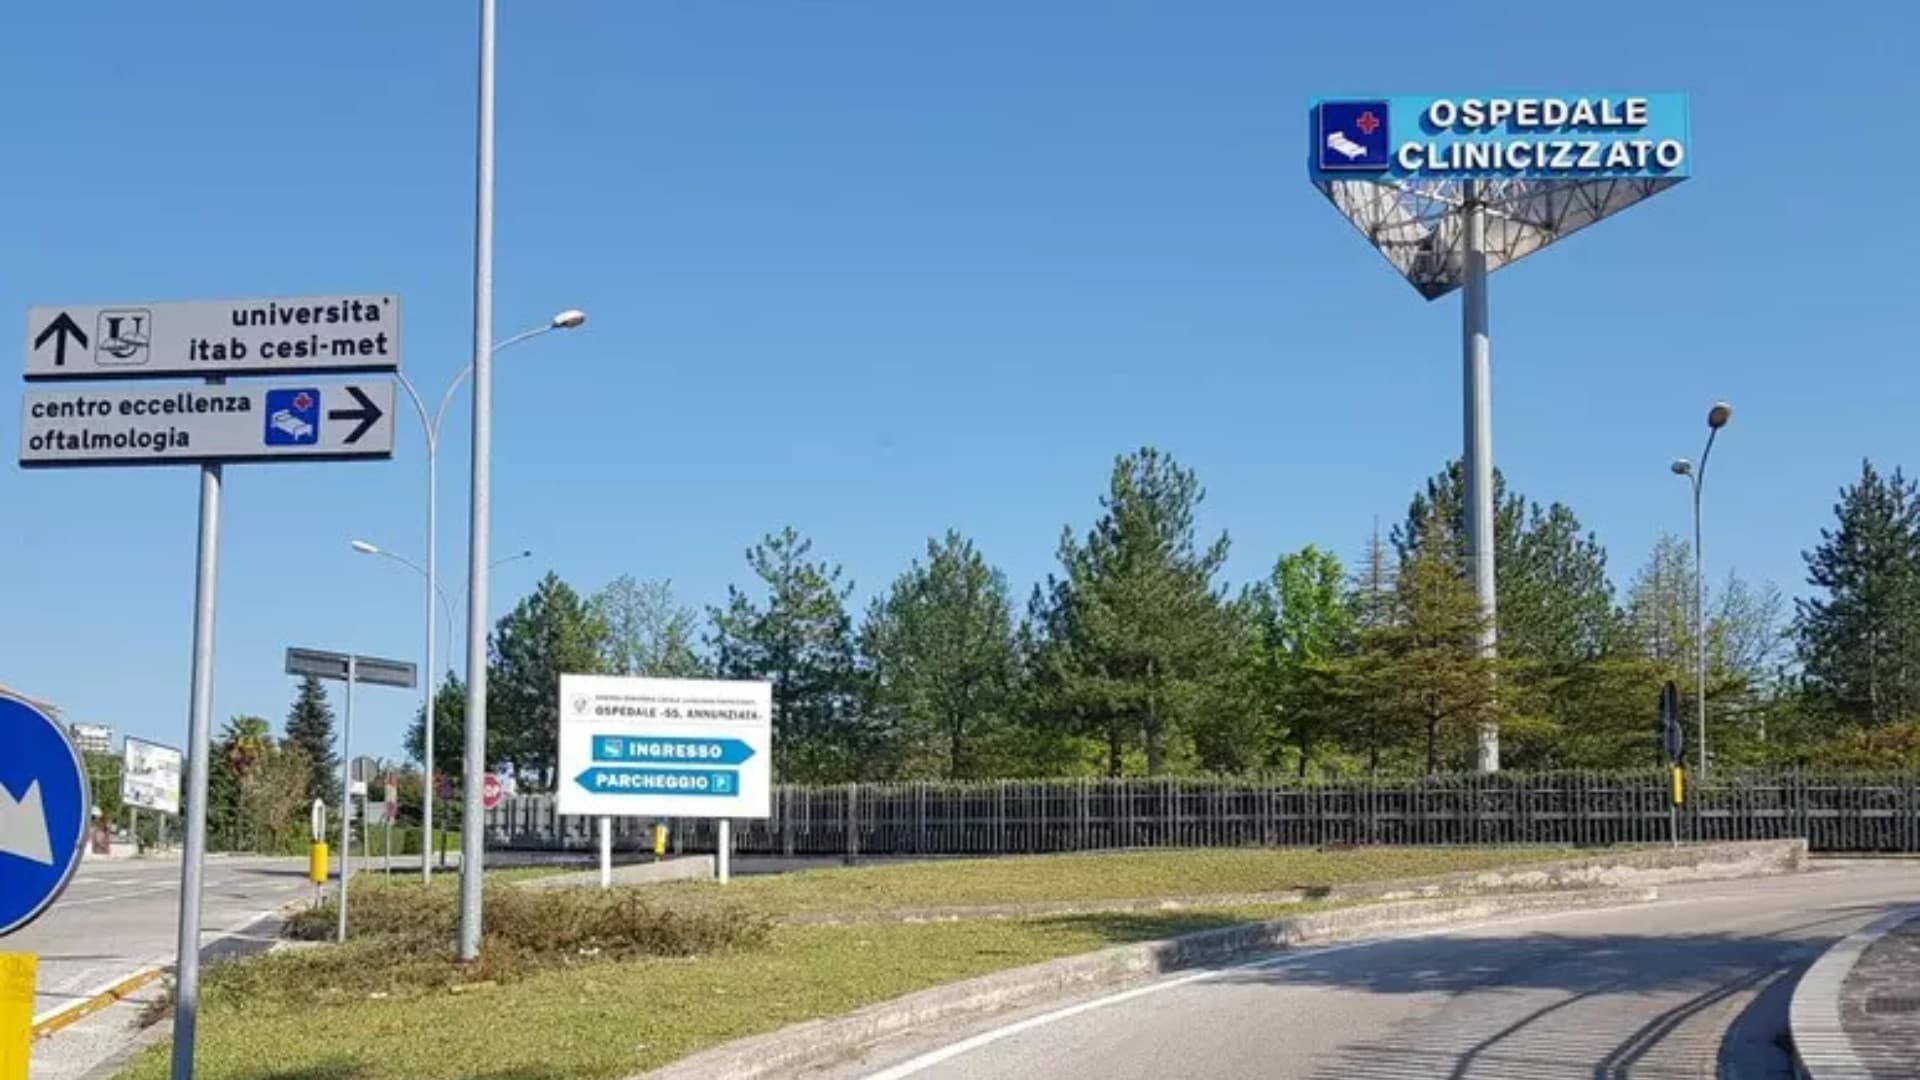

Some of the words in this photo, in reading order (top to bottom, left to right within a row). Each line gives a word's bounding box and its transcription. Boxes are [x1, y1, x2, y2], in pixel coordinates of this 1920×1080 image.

[1429, 98, 1648, 127] OSPEDALE
[1398, 139, 1684, 170] CLINICIZZATO
[189, 337, 247, 361] itab
[259, 332, 388, 359] cesi-met
[31, 396, 112, 419] centro
[118, 393, 252, 416] eccellenza
[29, 426, 190, 452] oftalmologia
[595, 705, 657, 718] OSPEDALE
[628, 742, 723, 759] INGRESSO
[595, 772, 709, 790] PARCHEGGIO
